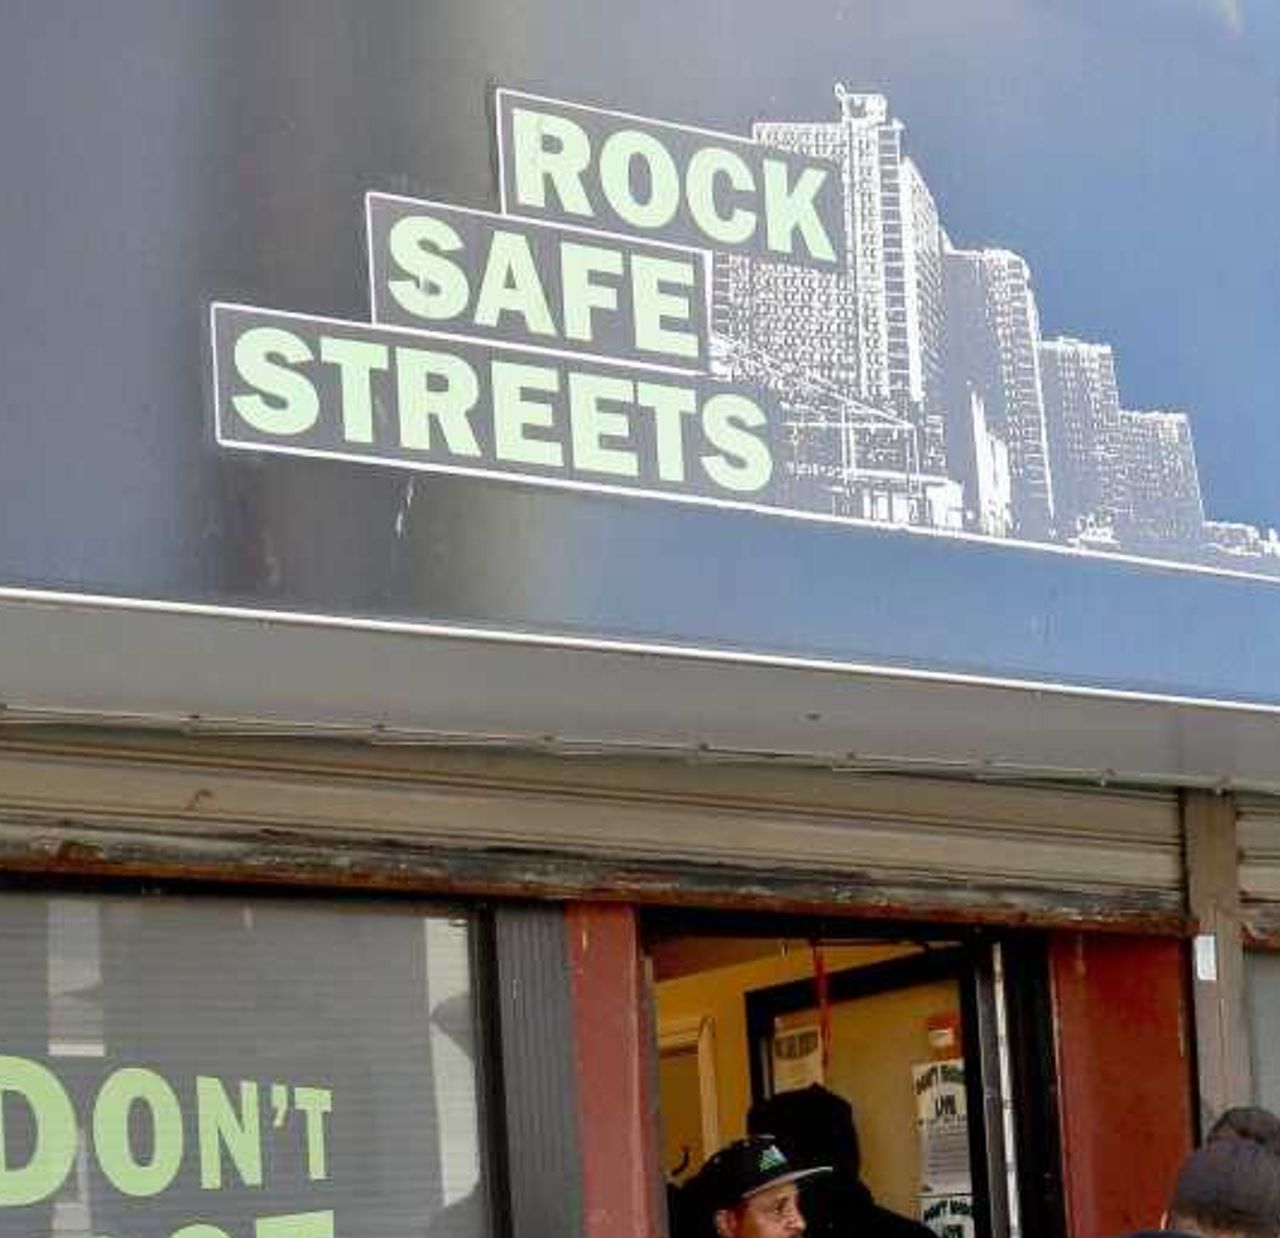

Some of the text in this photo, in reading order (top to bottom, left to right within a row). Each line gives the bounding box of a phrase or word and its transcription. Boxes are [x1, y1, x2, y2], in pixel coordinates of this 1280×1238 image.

[511, 108, 837, 263] ROCK
[387, 213, 700, 359] SAFE
[231, 326, 774, 493] STREETS
